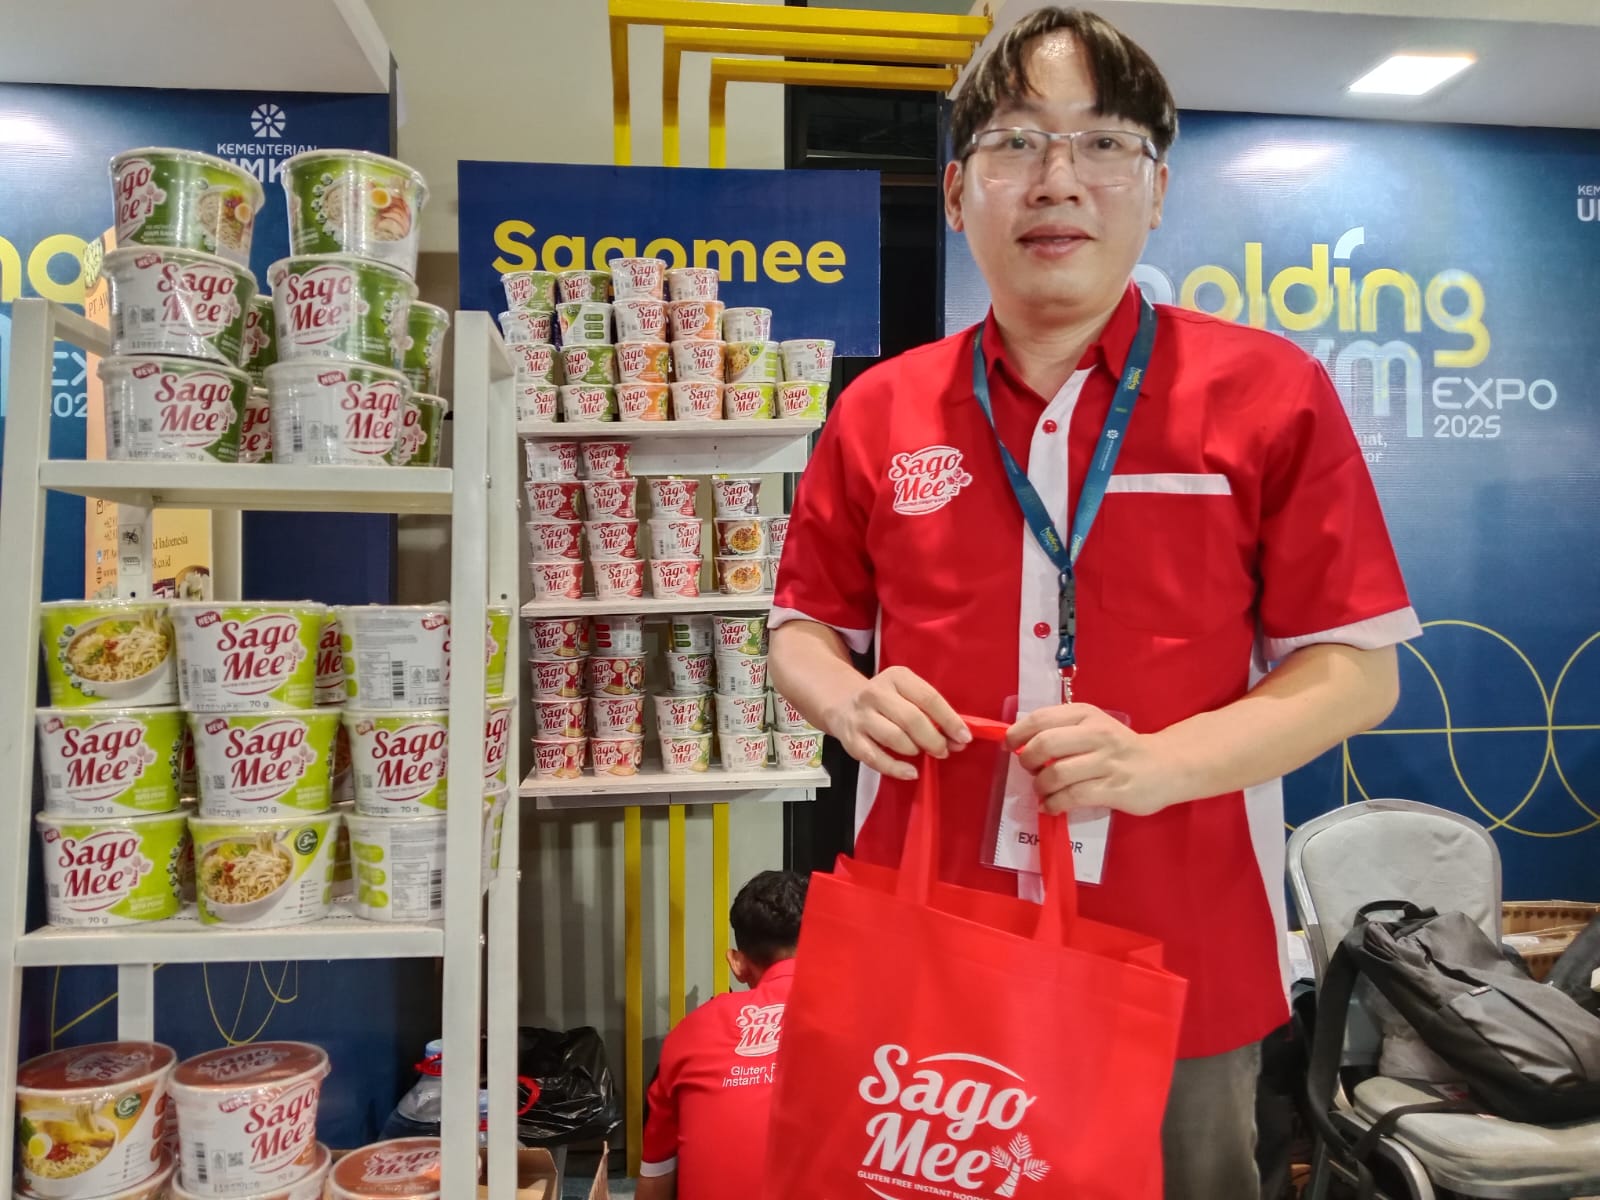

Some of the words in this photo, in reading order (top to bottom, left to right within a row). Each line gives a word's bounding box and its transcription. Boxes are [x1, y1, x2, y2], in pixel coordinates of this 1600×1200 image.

[116, 167, 151, 199] go
[118, 199, 140, 223] ee
[158, 264, 234, 300] Sago
[286, 275, 352, 305] Sago
[163, 295, 222, 321] Mee
[290, 302, 343, 332] Mee
[678, 307, 703, 319] Sago
[135, 364, 155, 377] NEW
[321, 373, 342, 384] NEW
[155, 374, 231, 410] Sago
[578, 392, 604, 403] Sago
[734, 390, 760, 402] Sago
[783, 388, 807, 400] Sago
[1432, 376, 1557, 410] EXPO
[160, 404, 219, 432] Mee
[345, 413, 393, 439] Mee
[1434, 414, 1501, 439] 2025
[891, 454, 961, 480] Sago
[534, 487, 559, 500] Sago
[594, 487, 619, 498] Sago
[659, 484, 685, 496] Sago
[895, 478, 946, 503] Mee
[541, 527, 568, 540] Sago
[600, 526, 626, 539] Sago
[660, 566, 685, 578] Sago
[198, 612, 217, 625] NEW
[720, 624, 746, 635] Sago
[217, 622, 298, 655] Sago
[534, 625, 561, 639] Sago
[223, 651, 286, 682] Mee
[537, 665, 563, 678] Sago
[541, 706, 568, 719] Sago
[208, 721, 224, 734] NEW
[61, 728, 144, 760] Sago
[225, 728, 305, 760] Sago
[371, 731, 447, 762] Sago
[485, 741, 505, 764] ee
[536, 747, 560, 759] Sago
[67, 758, 129, 788] Mee
[231, 758, 292, 788] Mee
[377, 759, 433, 788] Mee
[58, 838, 140, 872] Sago
[64, 868, 124, 898] Mee
[723, 1075, 760, 1087] Instant
[731, 1066, 766, 1076] Gluten
[858, 1044, 1037, 1141] Sago
[244, 1088, 316, 1133] Sago
[250, 1122, 306, 1163] Mee
[862, 1112, 992, 1190] Mee
[857, 1170, 890, 1184] GLUTEN
[892, 1178, 912, 1189] FREE
[914, 1184, 952, 1198] INSTANT
